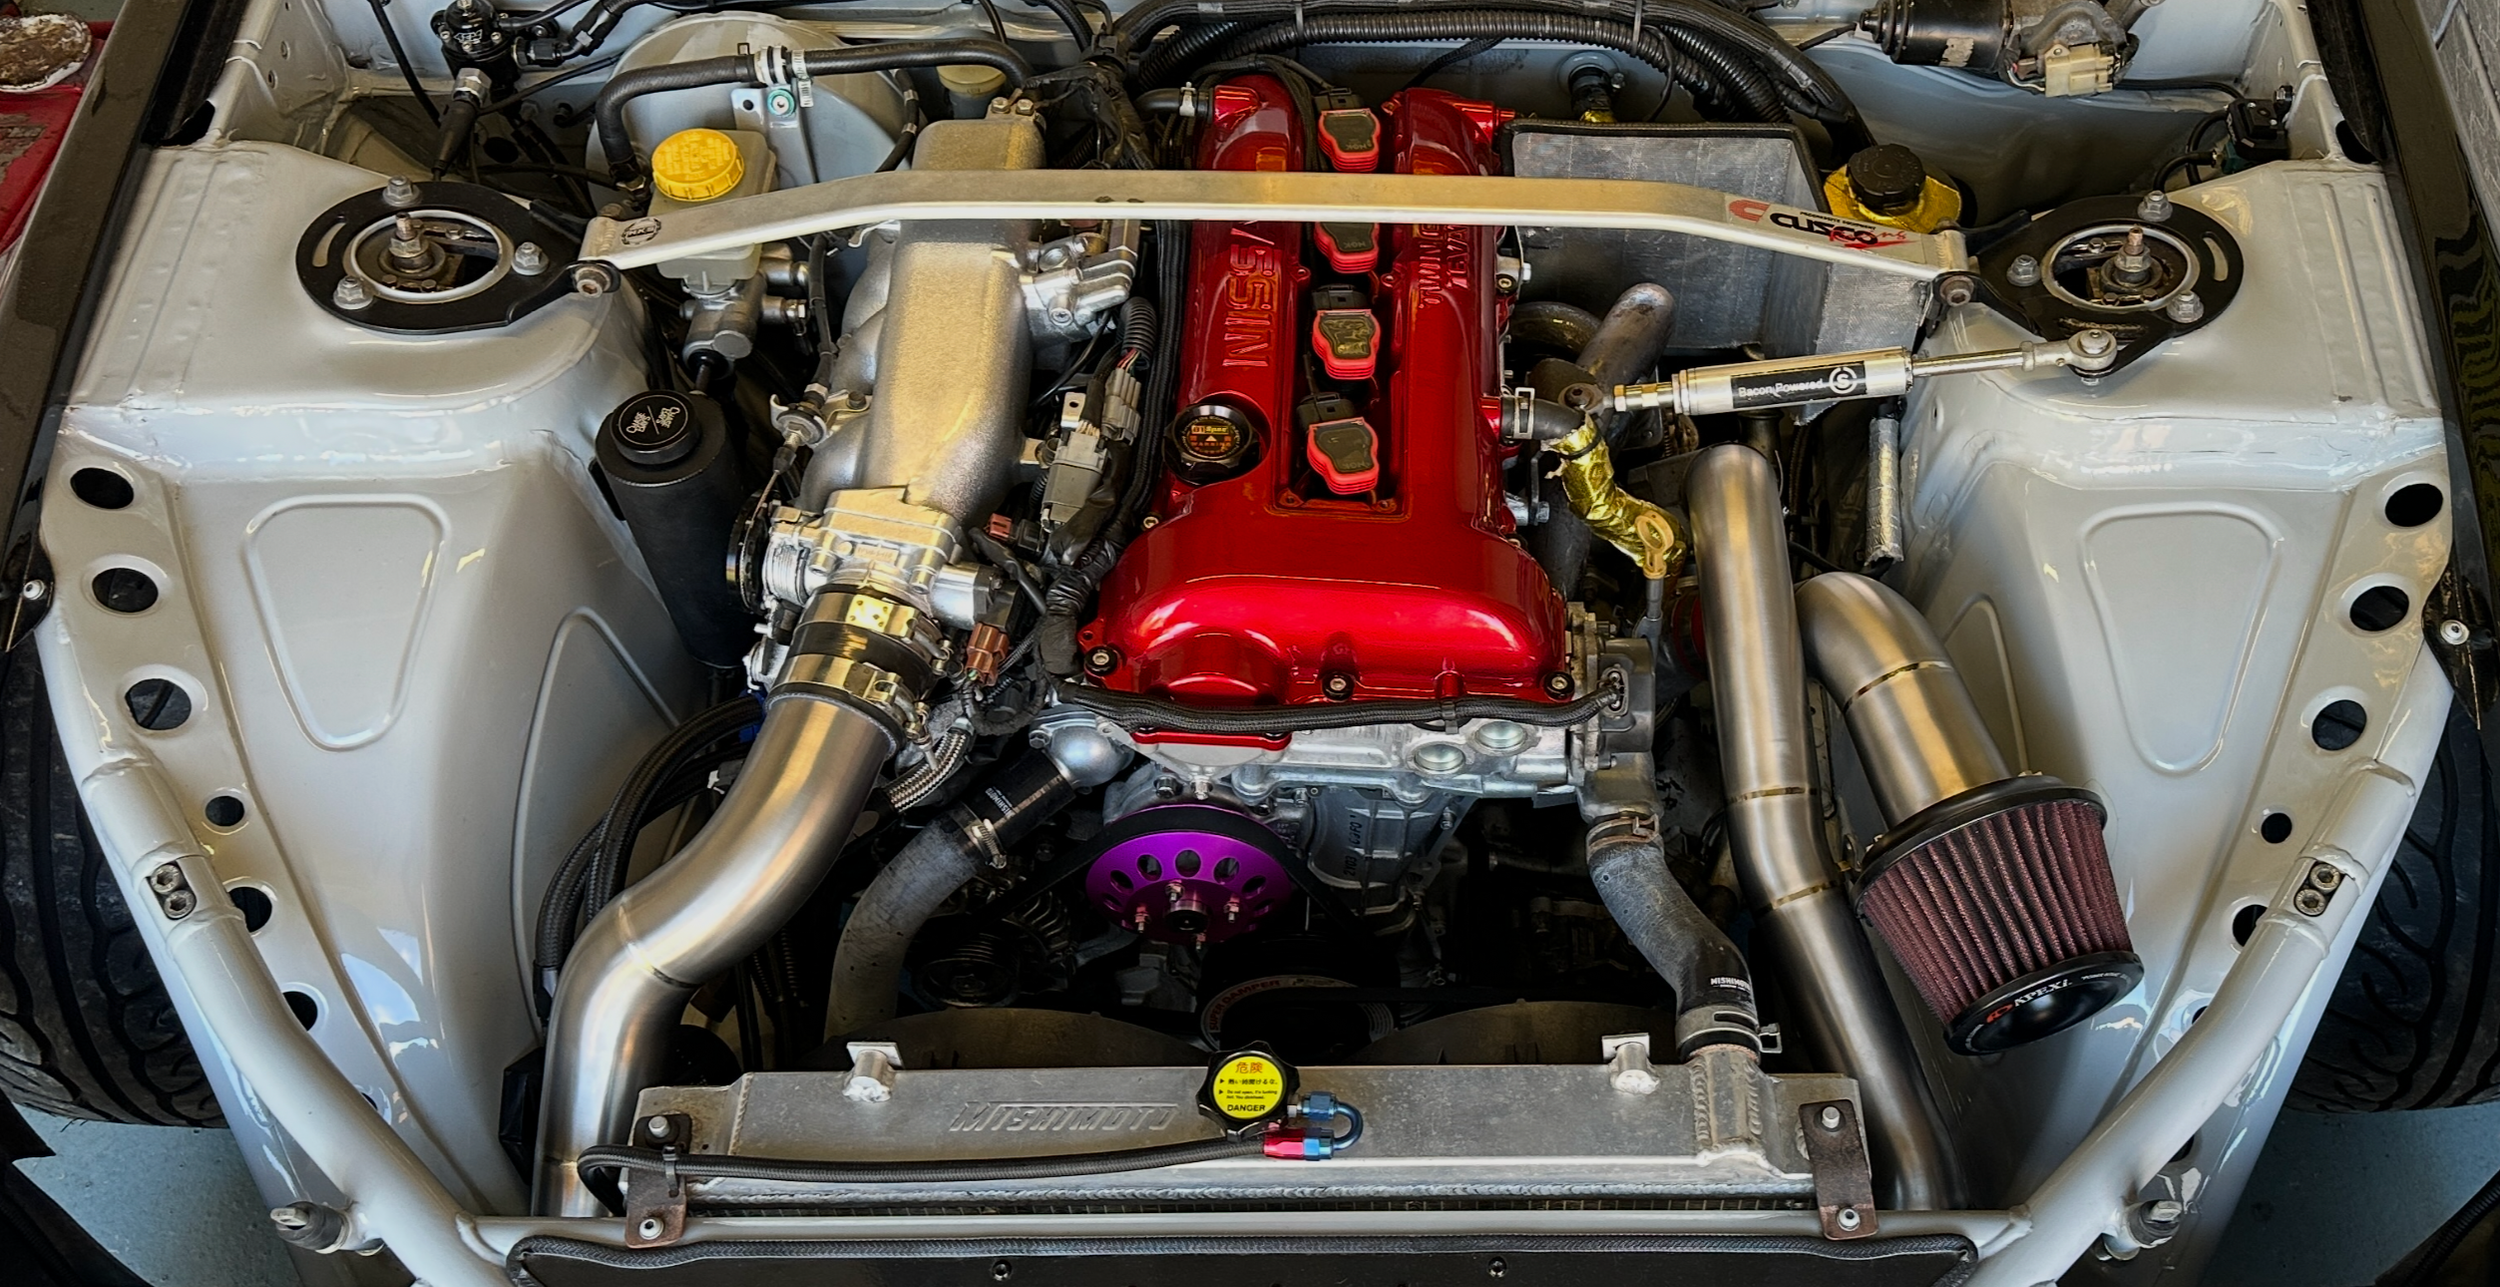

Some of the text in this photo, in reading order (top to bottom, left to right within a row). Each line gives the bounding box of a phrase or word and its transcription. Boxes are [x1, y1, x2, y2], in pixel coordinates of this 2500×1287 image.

[1222, 220, 1276, 367] NISSA
[1738, 378, 1823, 397] Bacon Powered
[1209, 979, 1281, 1031] SUPER DAMPER
[949, 1101, 1179, 1132] MISHIMOTO
